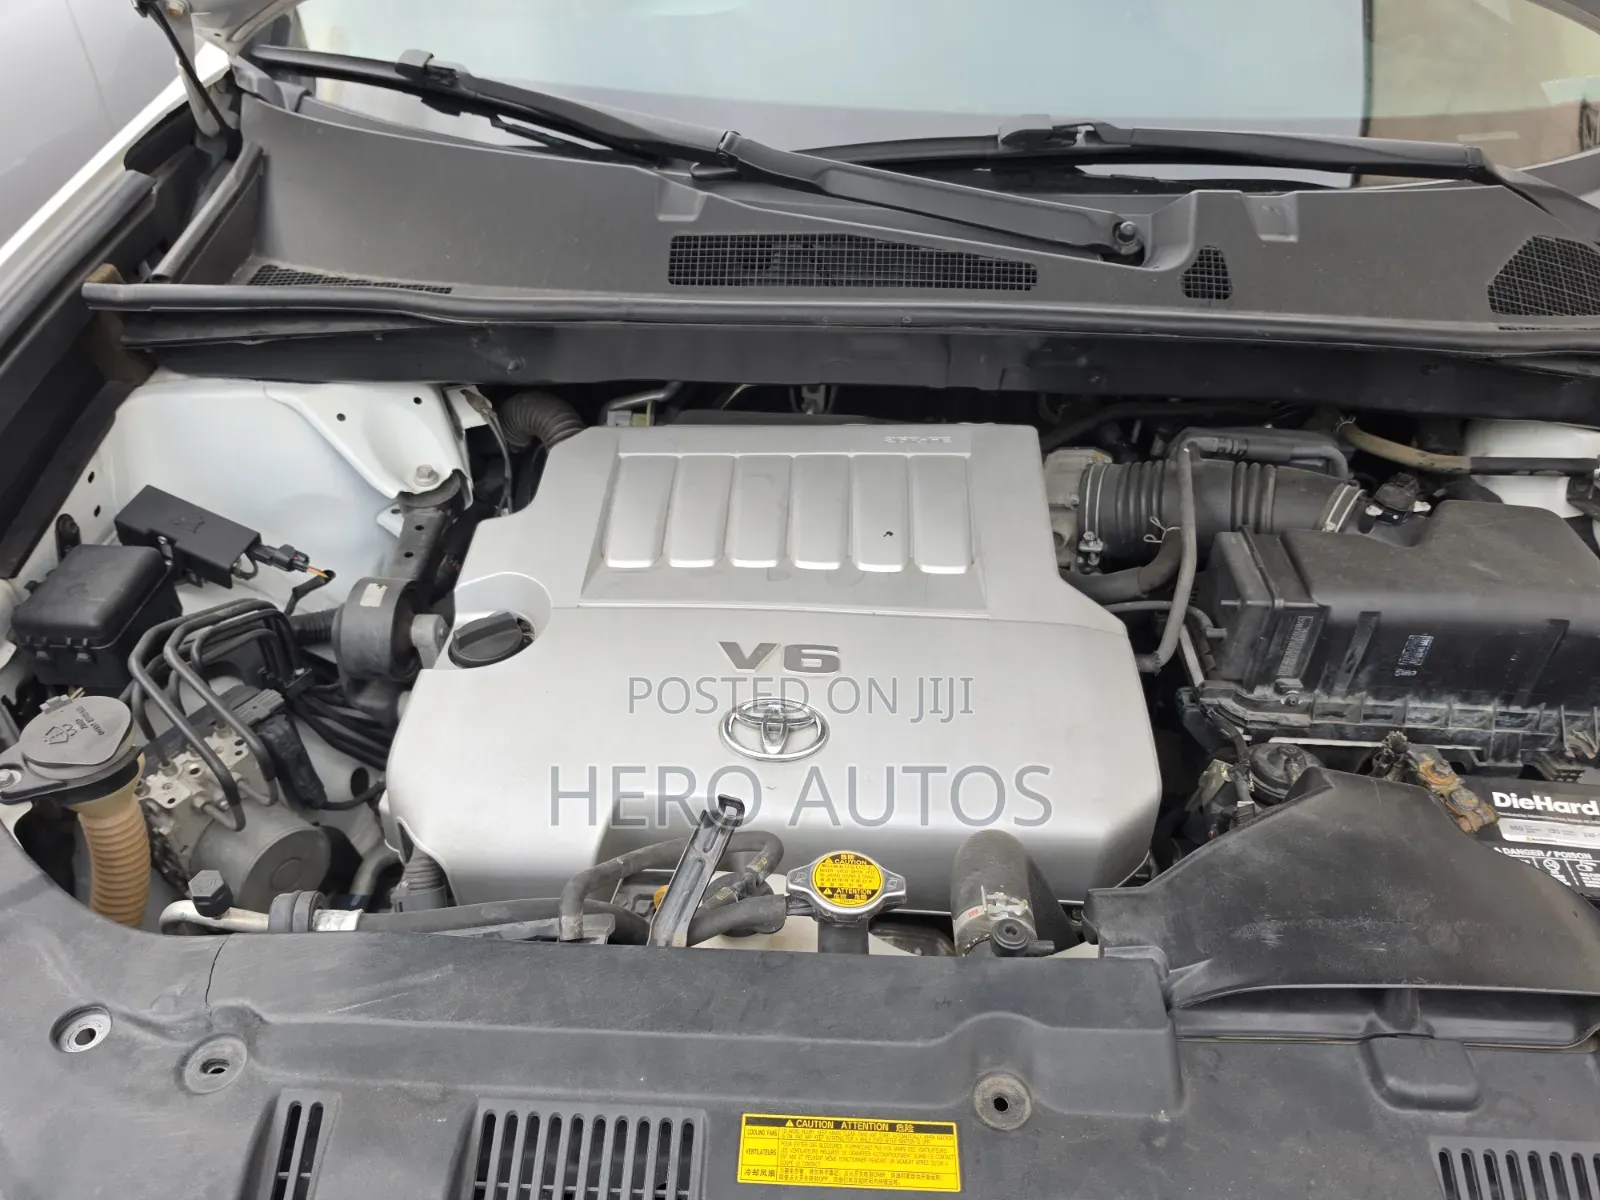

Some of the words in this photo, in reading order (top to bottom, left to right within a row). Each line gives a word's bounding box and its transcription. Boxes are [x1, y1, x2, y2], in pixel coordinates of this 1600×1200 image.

[716, 641, 841, 675] V6
[1492, 792, 1600, 816] DieHard
[1502, 847, 1545, 857] DANGER
[1554, 851, 1593, 860] POISON
[836, 887, 872, 895] ATTENTION
[796, 1119, 834, 1129] CAUTION
[841, 1121, 889, 1131] ATTENTION
[746, 1148, 776, 1156] VENTILATEURS
